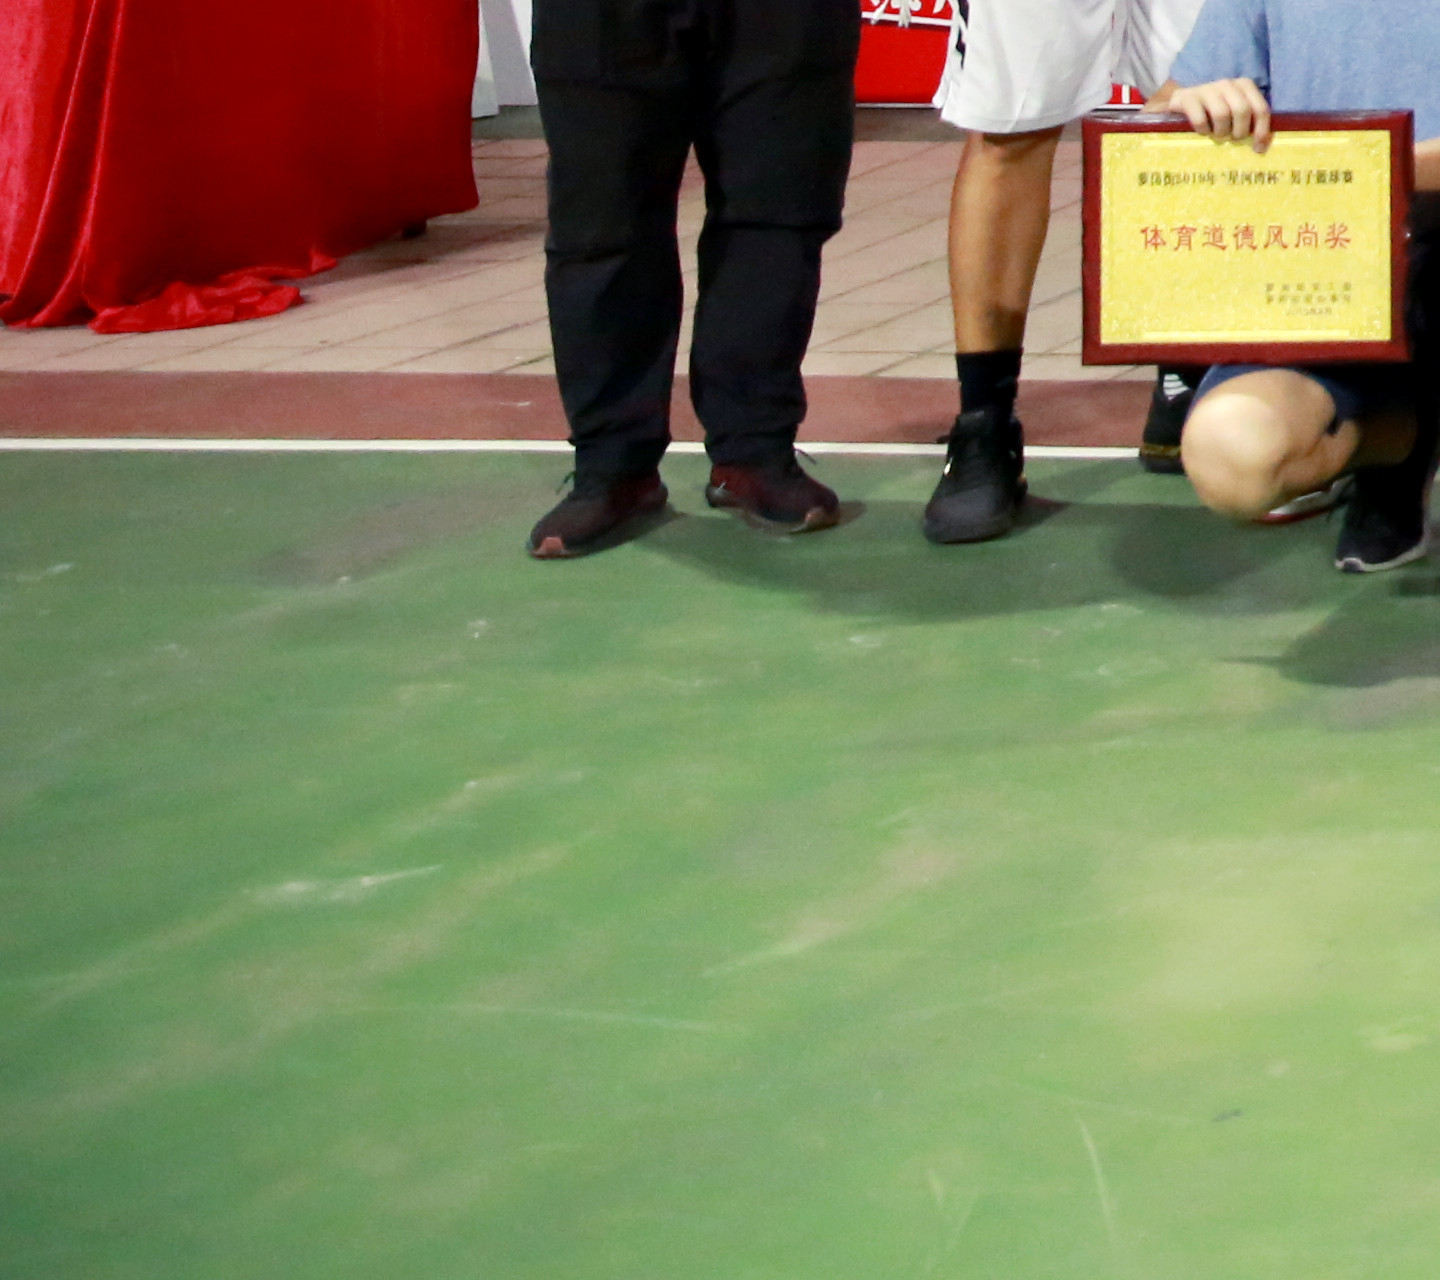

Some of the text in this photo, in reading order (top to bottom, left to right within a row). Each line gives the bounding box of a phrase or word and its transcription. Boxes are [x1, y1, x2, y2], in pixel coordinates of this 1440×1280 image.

[1140, 223, 1352, 251] 体育道德风尚奖
